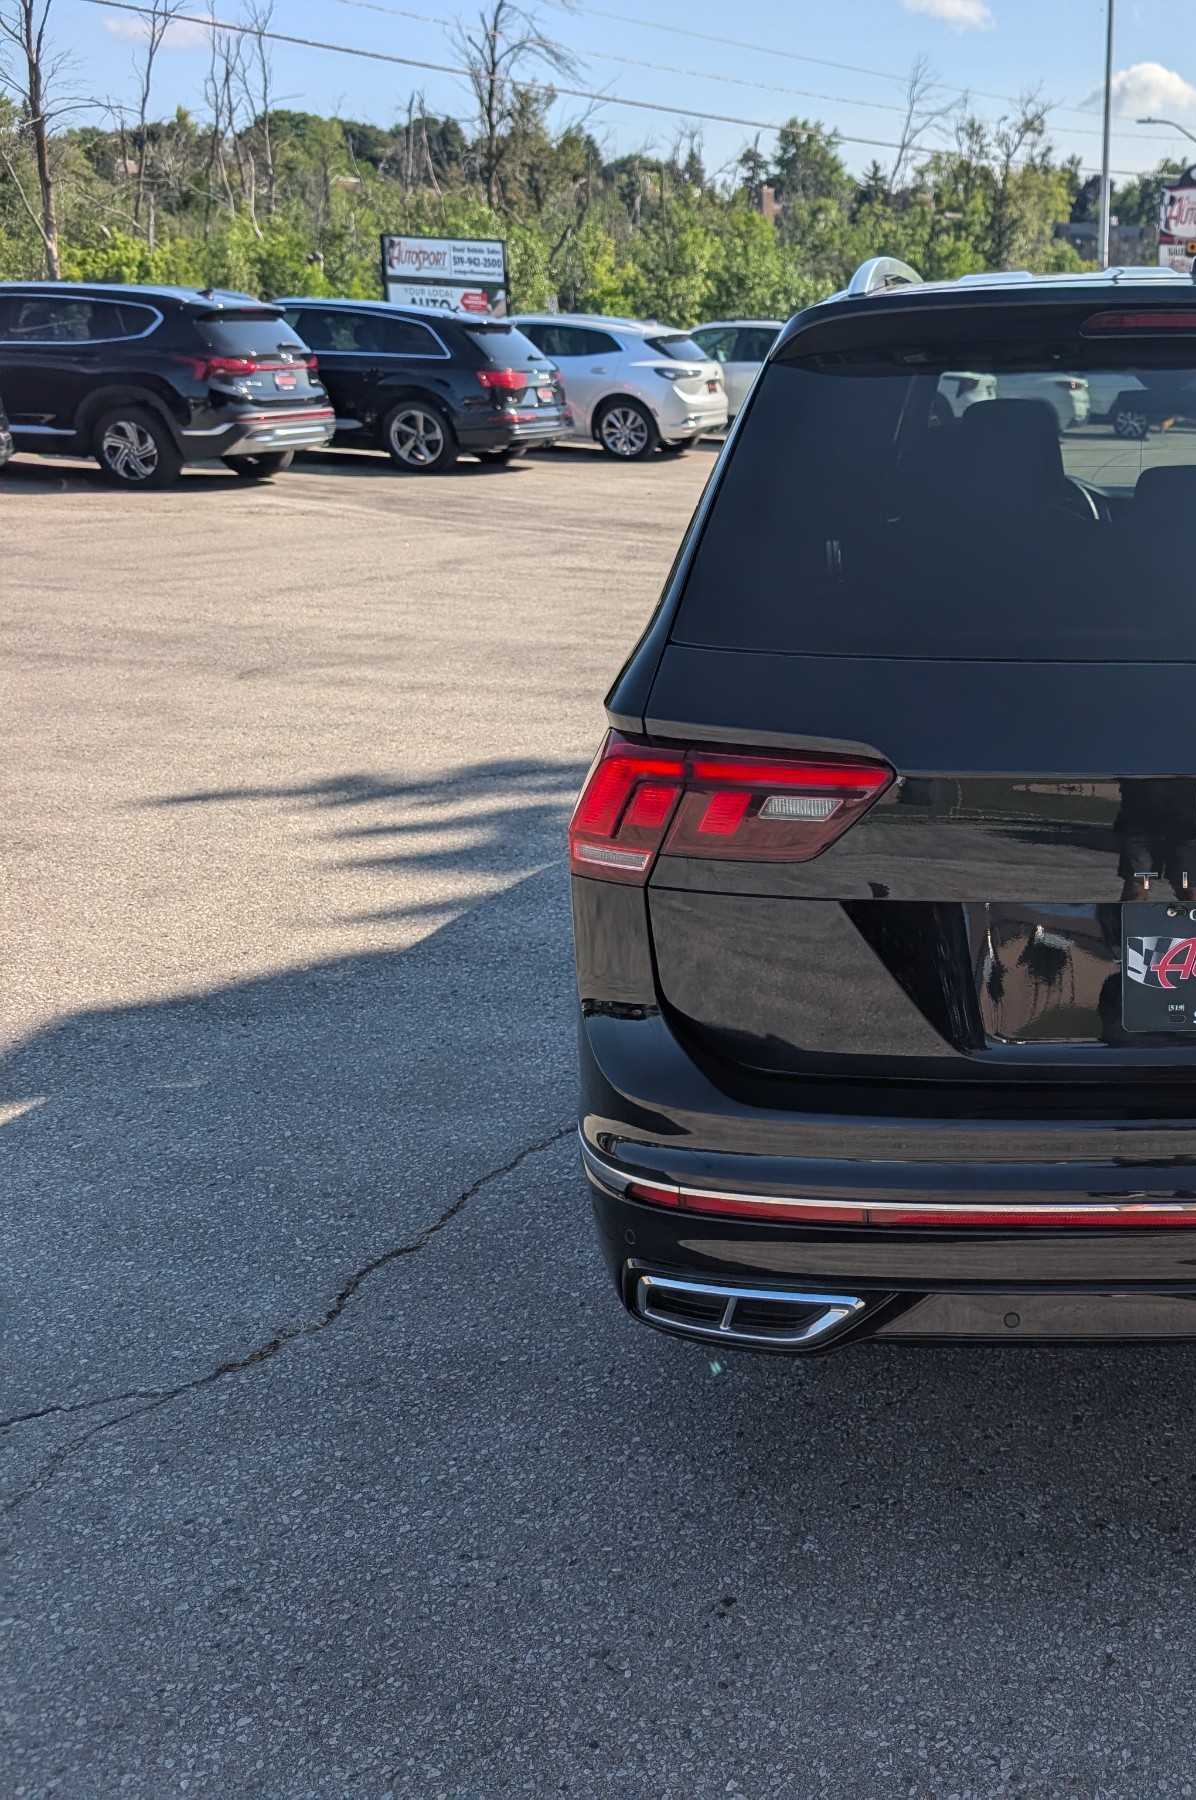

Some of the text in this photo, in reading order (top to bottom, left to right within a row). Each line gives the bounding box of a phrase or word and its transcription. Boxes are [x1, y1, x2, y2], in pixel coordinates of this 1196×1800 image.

[389, 241, 447, 271] AUTOSPORT
[403, 287, 454, 298] YOUR LOCAL
